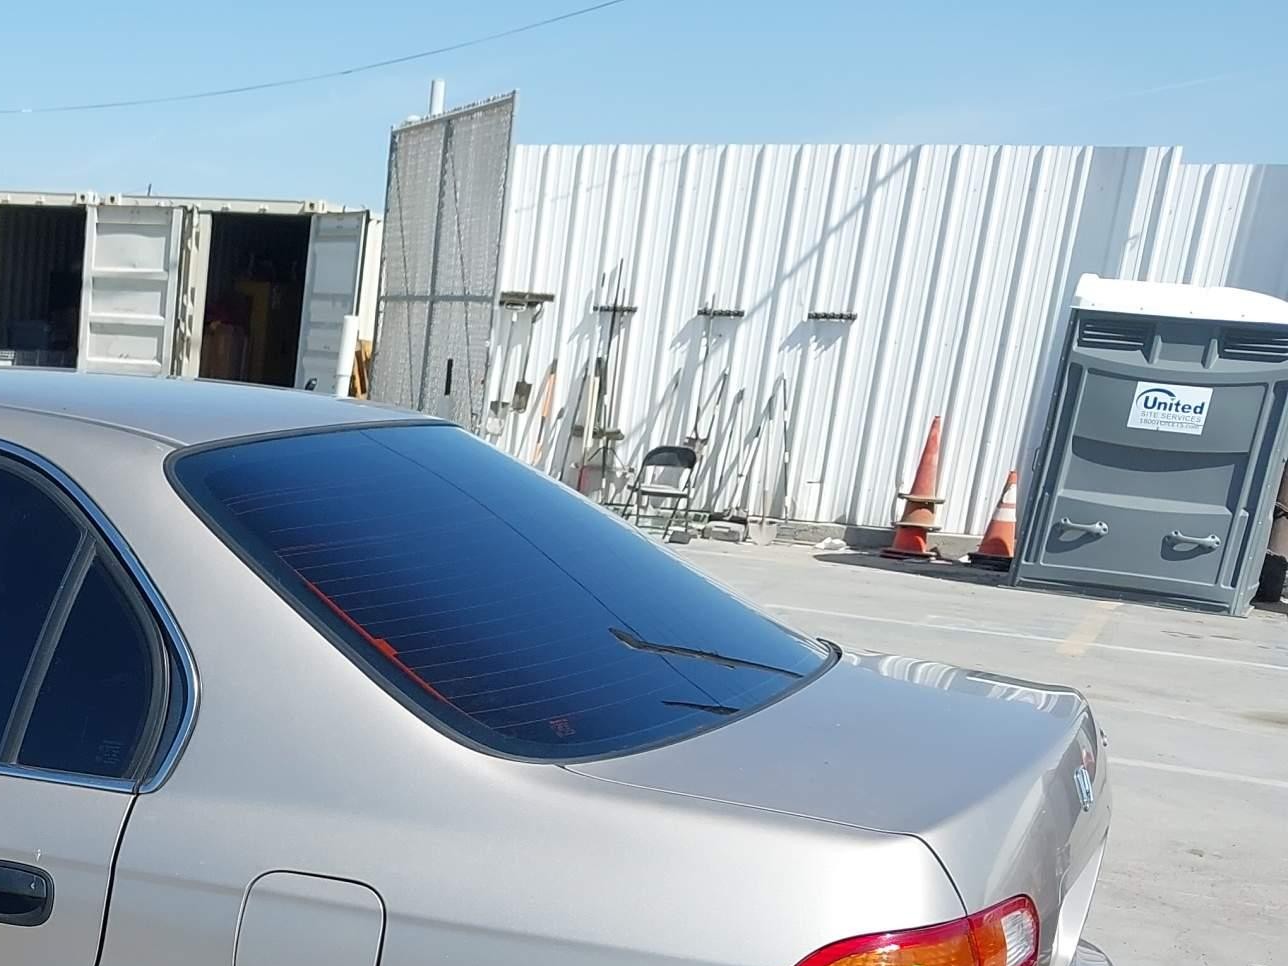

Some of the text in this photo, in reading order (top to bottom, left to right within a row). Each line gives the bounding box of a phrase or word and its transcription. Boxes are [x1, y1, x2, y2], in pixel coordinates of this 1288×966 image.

[1143, 395, 1205, 415] United
[1140, 410, 1202, 423] SITE SERVICES
